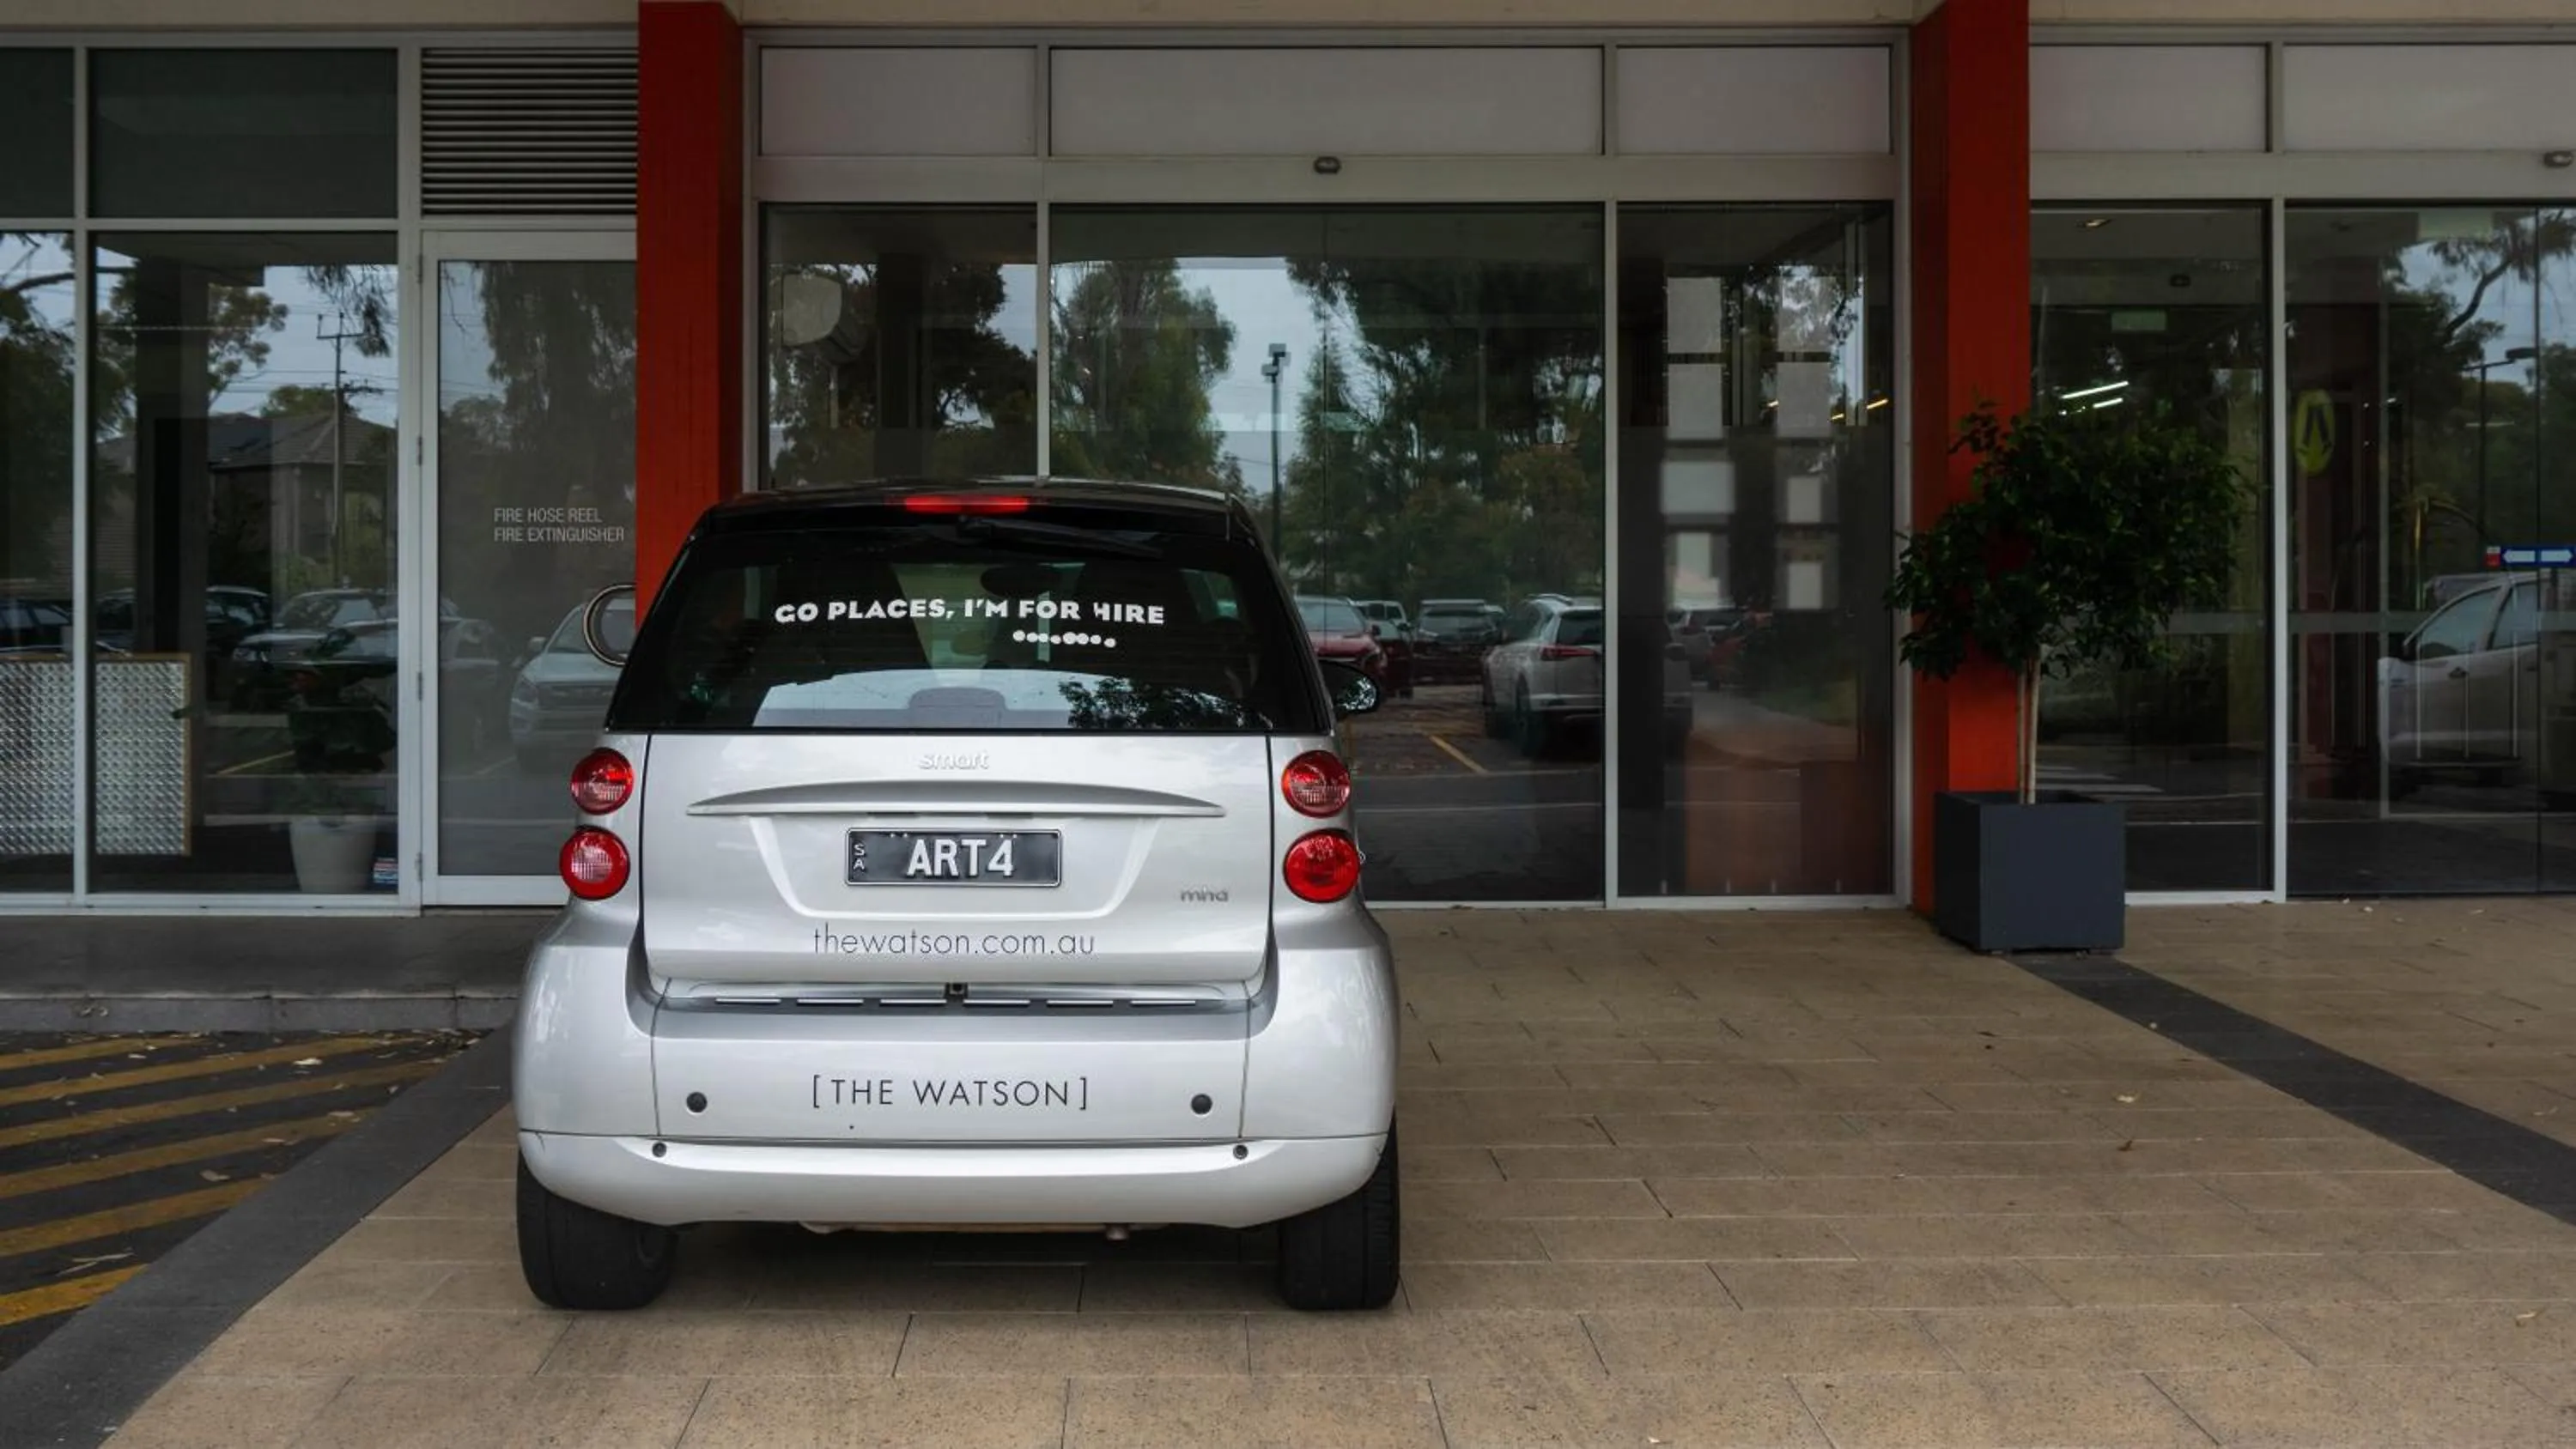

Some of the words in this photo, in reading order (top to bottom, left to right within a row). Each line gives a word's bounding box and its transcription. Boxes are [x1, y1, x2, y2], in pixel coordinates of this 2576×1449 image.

[494, 507, 523, 523] FIRE
[527, 507, 564, 523] HOSE
[568, 507, 603, 523] REEL
[494, 526, 524, 543] FIRE
[527, 526, 624, 543] EXTINGUISHER
[774, 603, 819, 623] GO
[827, 597, 954, 620] PLACES,
[964, 597, 1008, 618] I'M
[1018, 599, 1081, 621] FOR
[1093, 602, 1165, 625] HIRE
[917, 750, 989, 770] smart
[906, 838, 1015, 877] ART4
[814, 922, 1095, 955] thewatson.com.au
